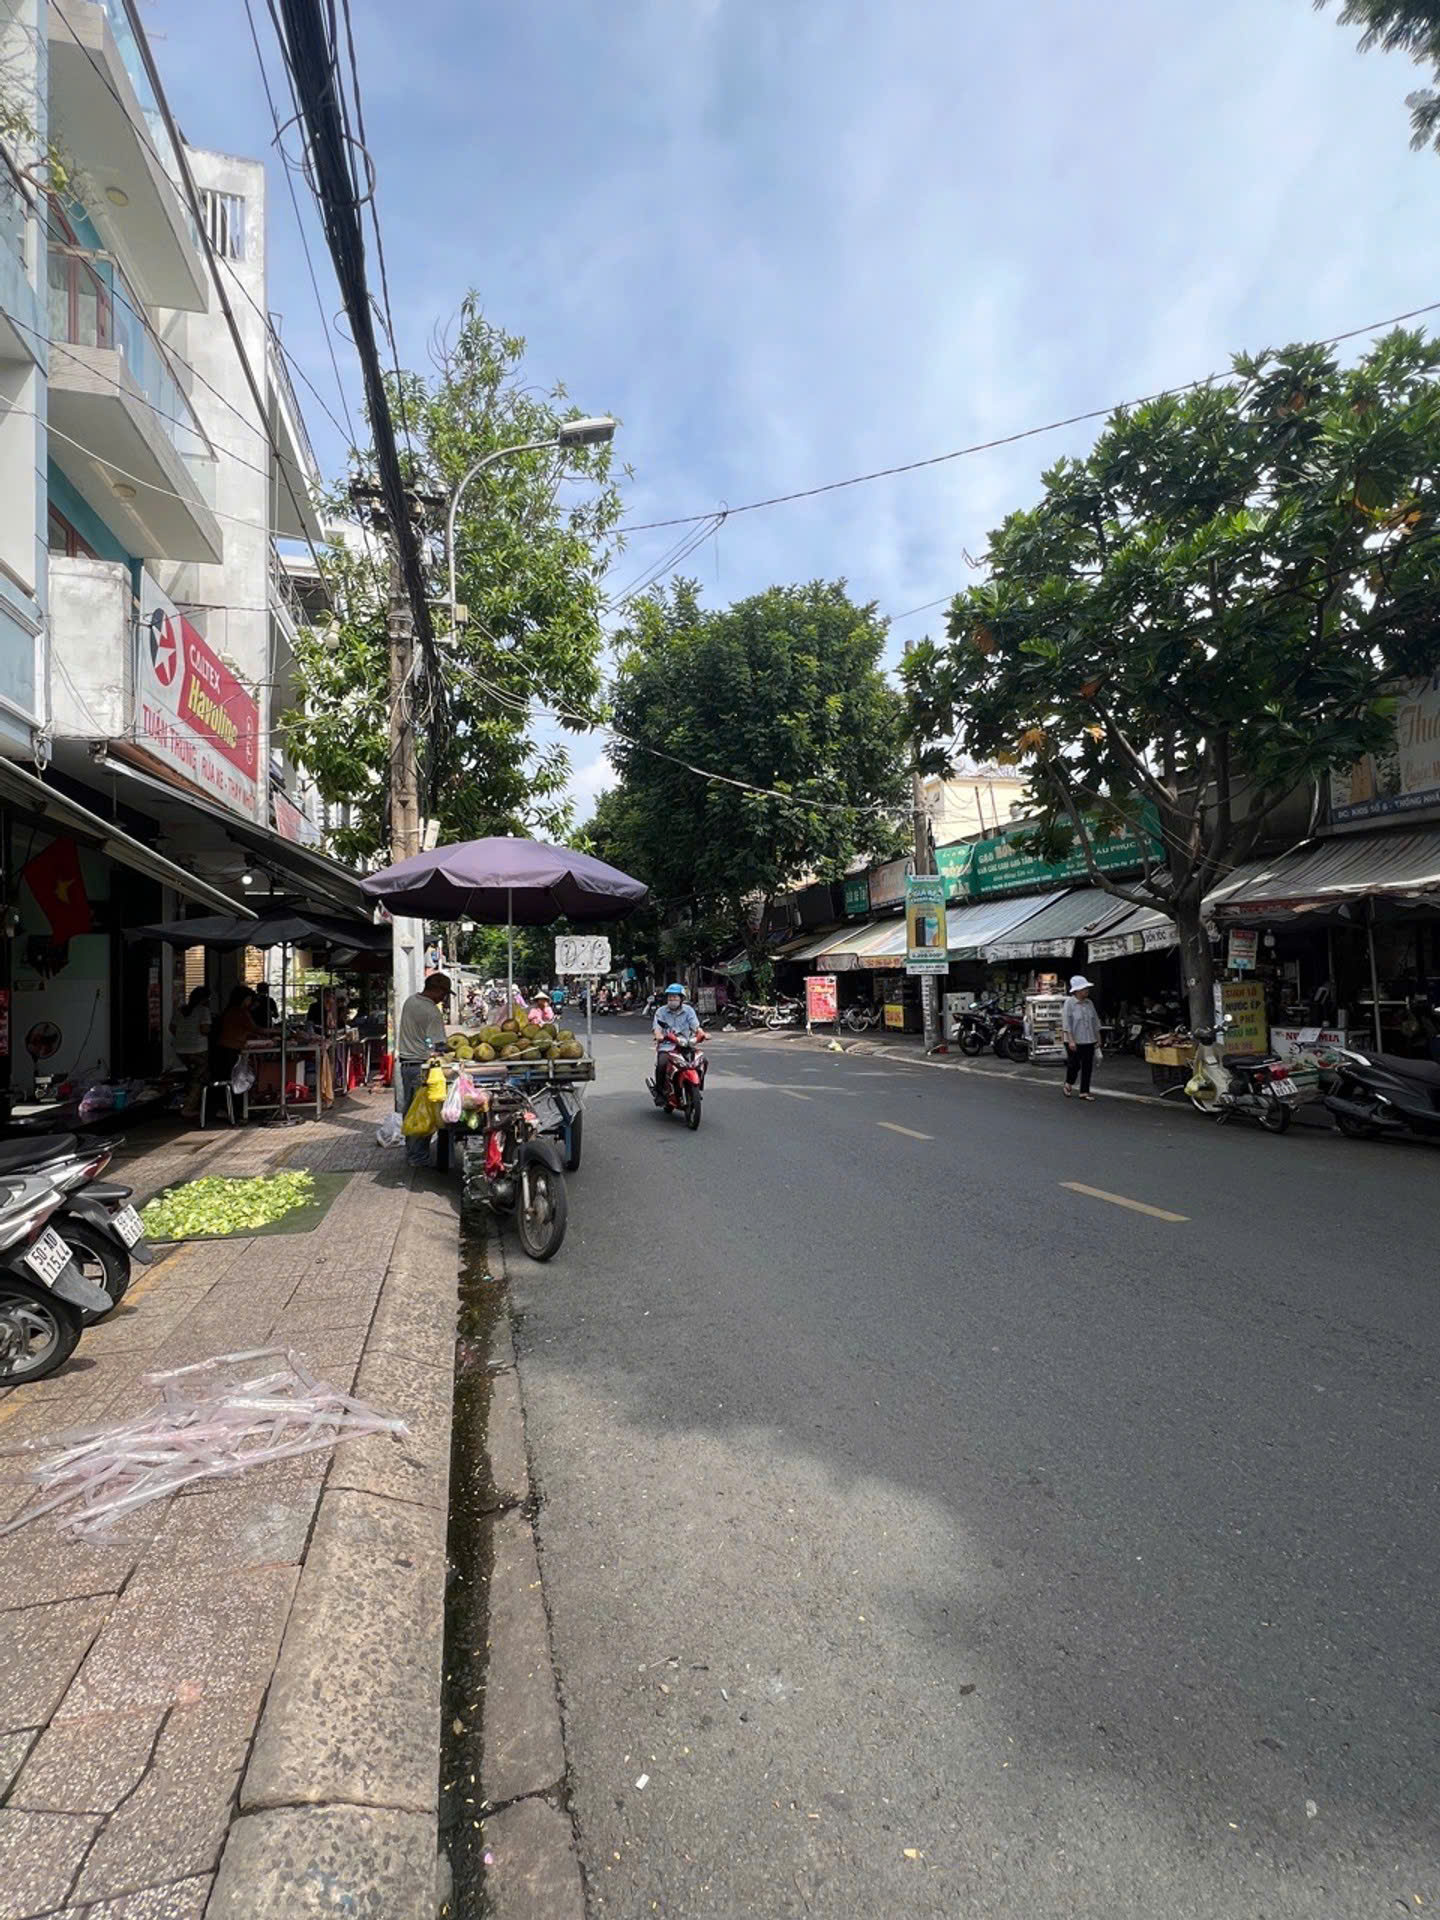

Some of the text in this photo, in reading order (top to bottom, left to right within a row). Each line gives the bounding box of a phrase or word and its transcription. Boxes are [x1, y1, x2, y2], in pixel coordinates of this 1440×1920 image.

[189, 643, 220, 696] CALTEX
[187, 673, 238, 750] Havoline
[31, 1232, 58, 1266] 50-AD
[43, 1243, 70, 1280] 115.44
